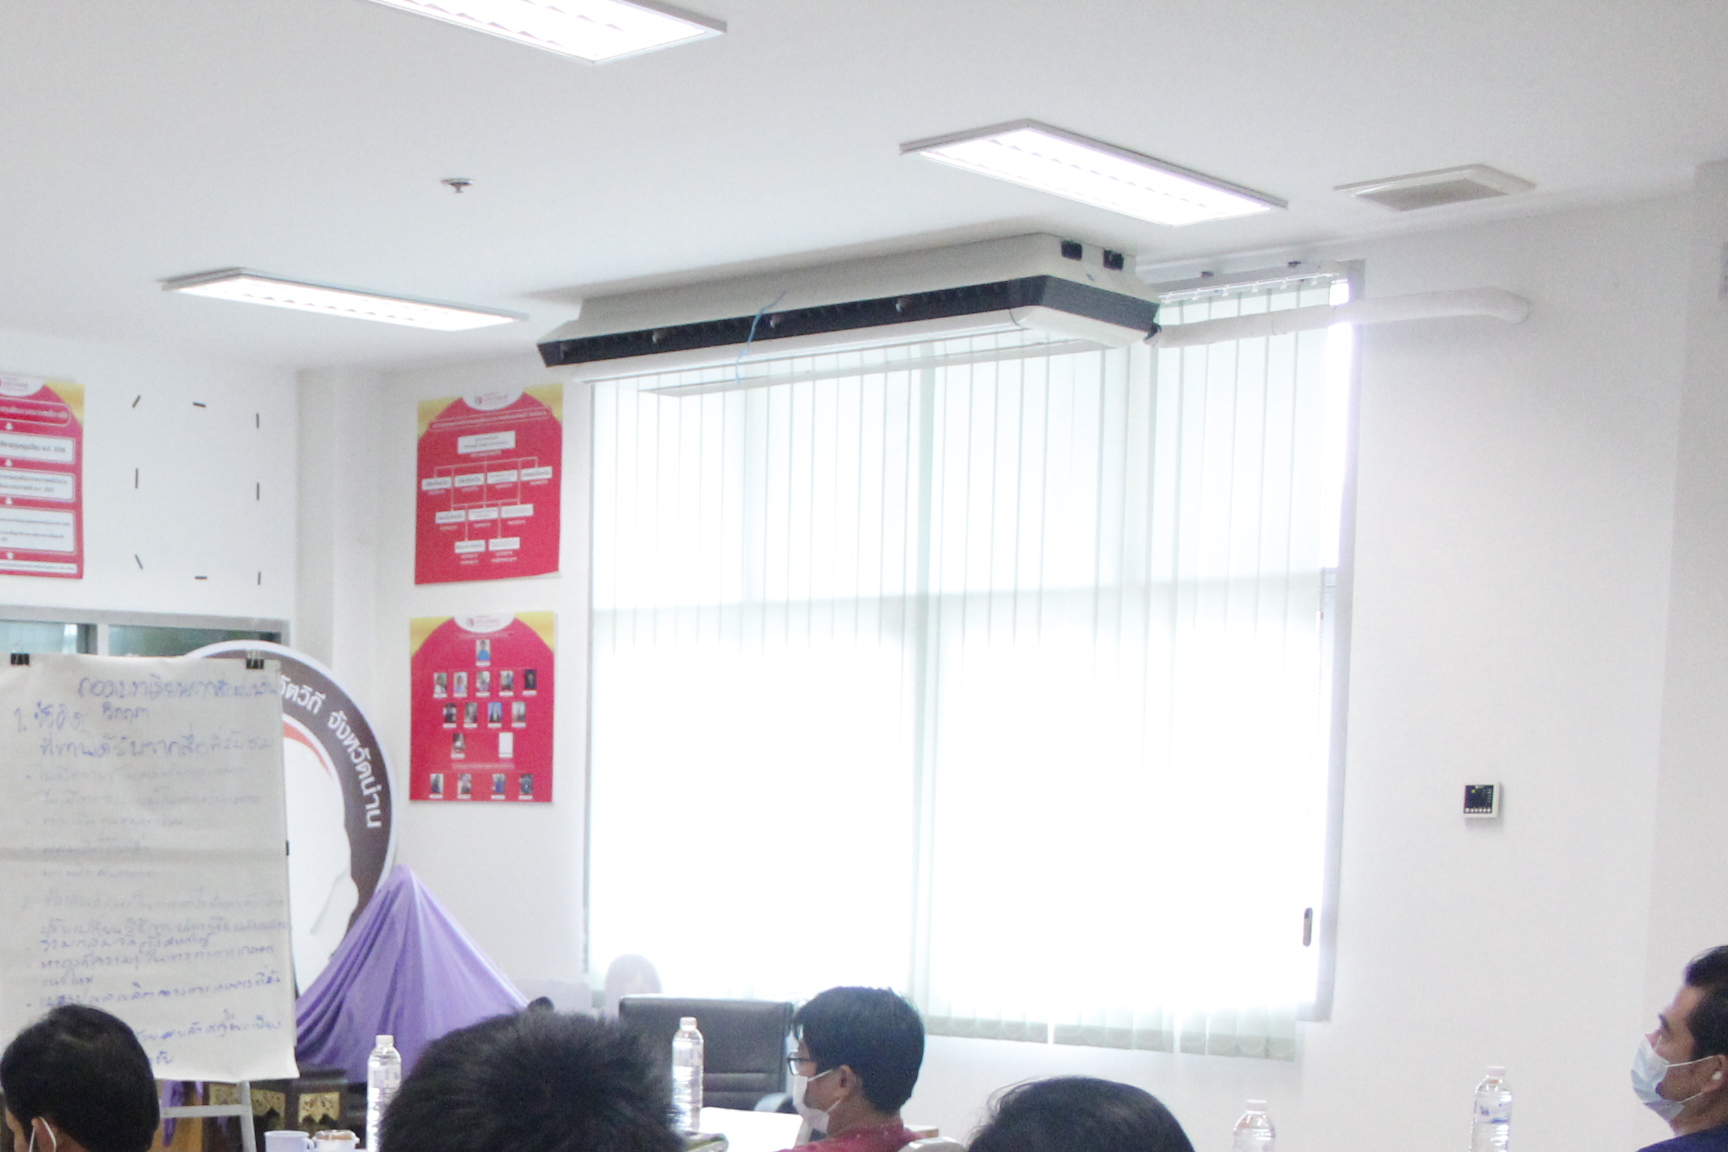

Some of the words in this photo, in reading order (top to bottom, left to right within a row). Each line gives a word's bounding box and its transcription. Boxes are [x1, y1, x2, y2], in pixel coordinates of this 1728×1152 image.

[327, 709, 383, 829] จังหวัดน่าน
